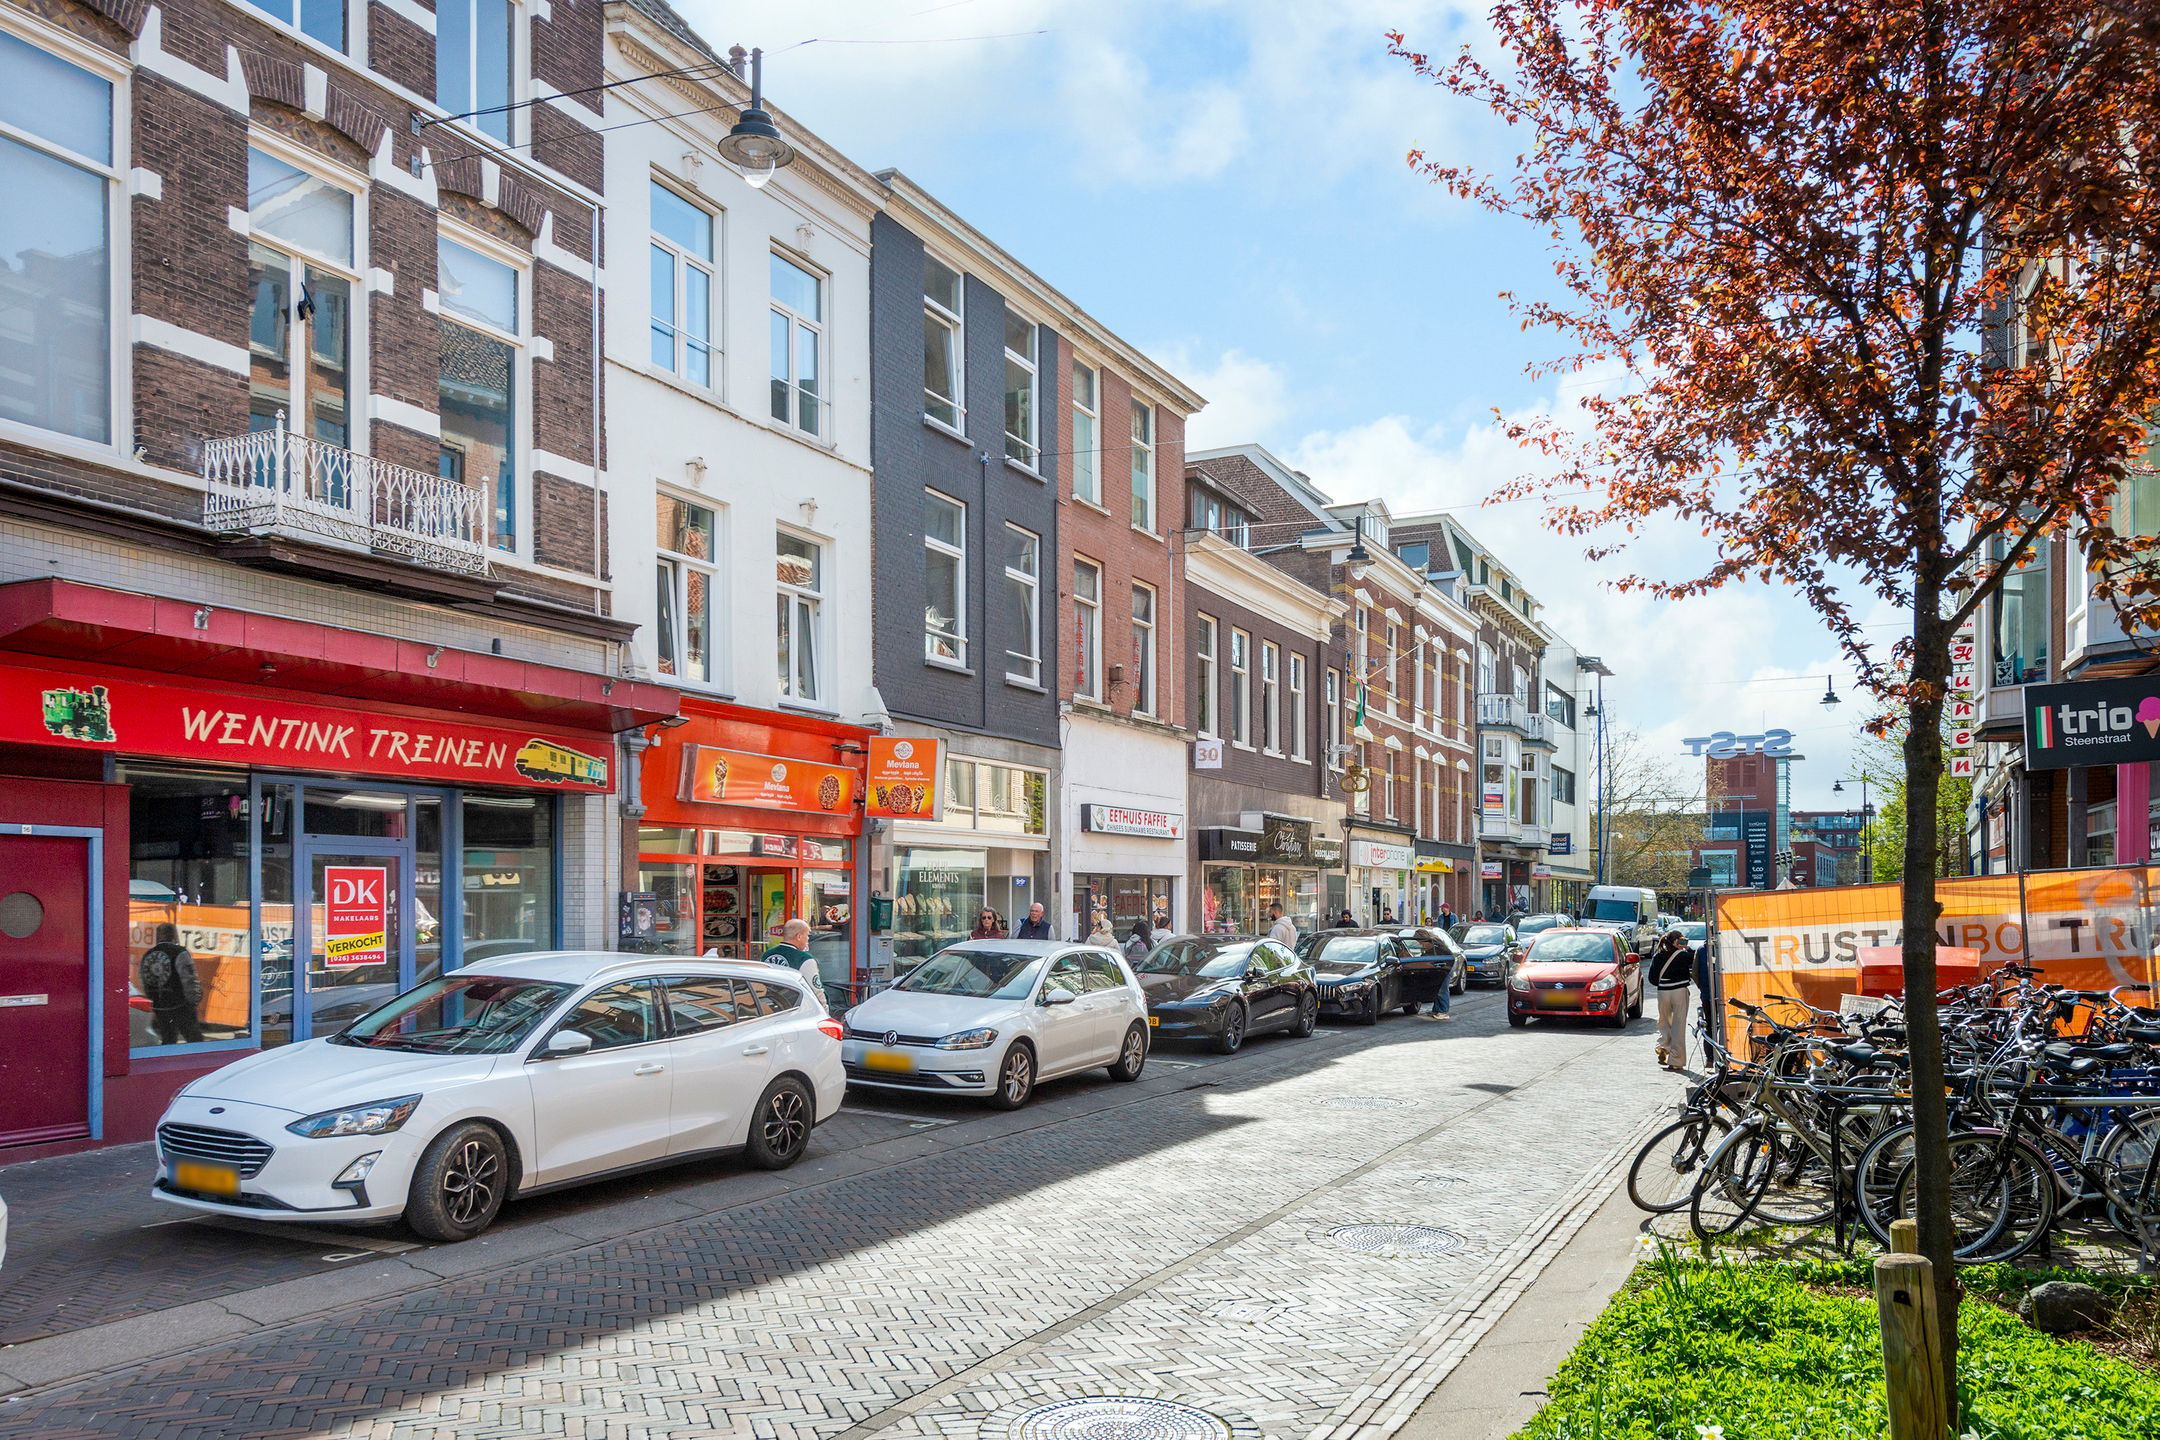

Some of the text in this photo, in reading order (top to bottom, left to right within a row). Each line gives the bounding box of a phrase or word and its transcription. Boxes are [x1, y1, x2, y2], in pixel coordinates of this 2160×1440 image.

[2058, 701, 2133, 735] trio
[182, 706, 507, 769] WENTINK TREINEN
[2065, 733, 2132, 747] Steenstraat
[886, 759, 920, 769] Mevlana
[1109, 809, 1167, 828] EETHUIS FAFFIE
[1147, 827, 1170, 836] RESTAURANT
[1231, 840, 1257, 852] PATISSERIE
[919, 871, 960, 883] ELEMENTS
[333, 879, 379, 905] DK
[327, 935, 384, 954] VERKOCHT
[2041, 1133, 2084, 1169] Gazelle
